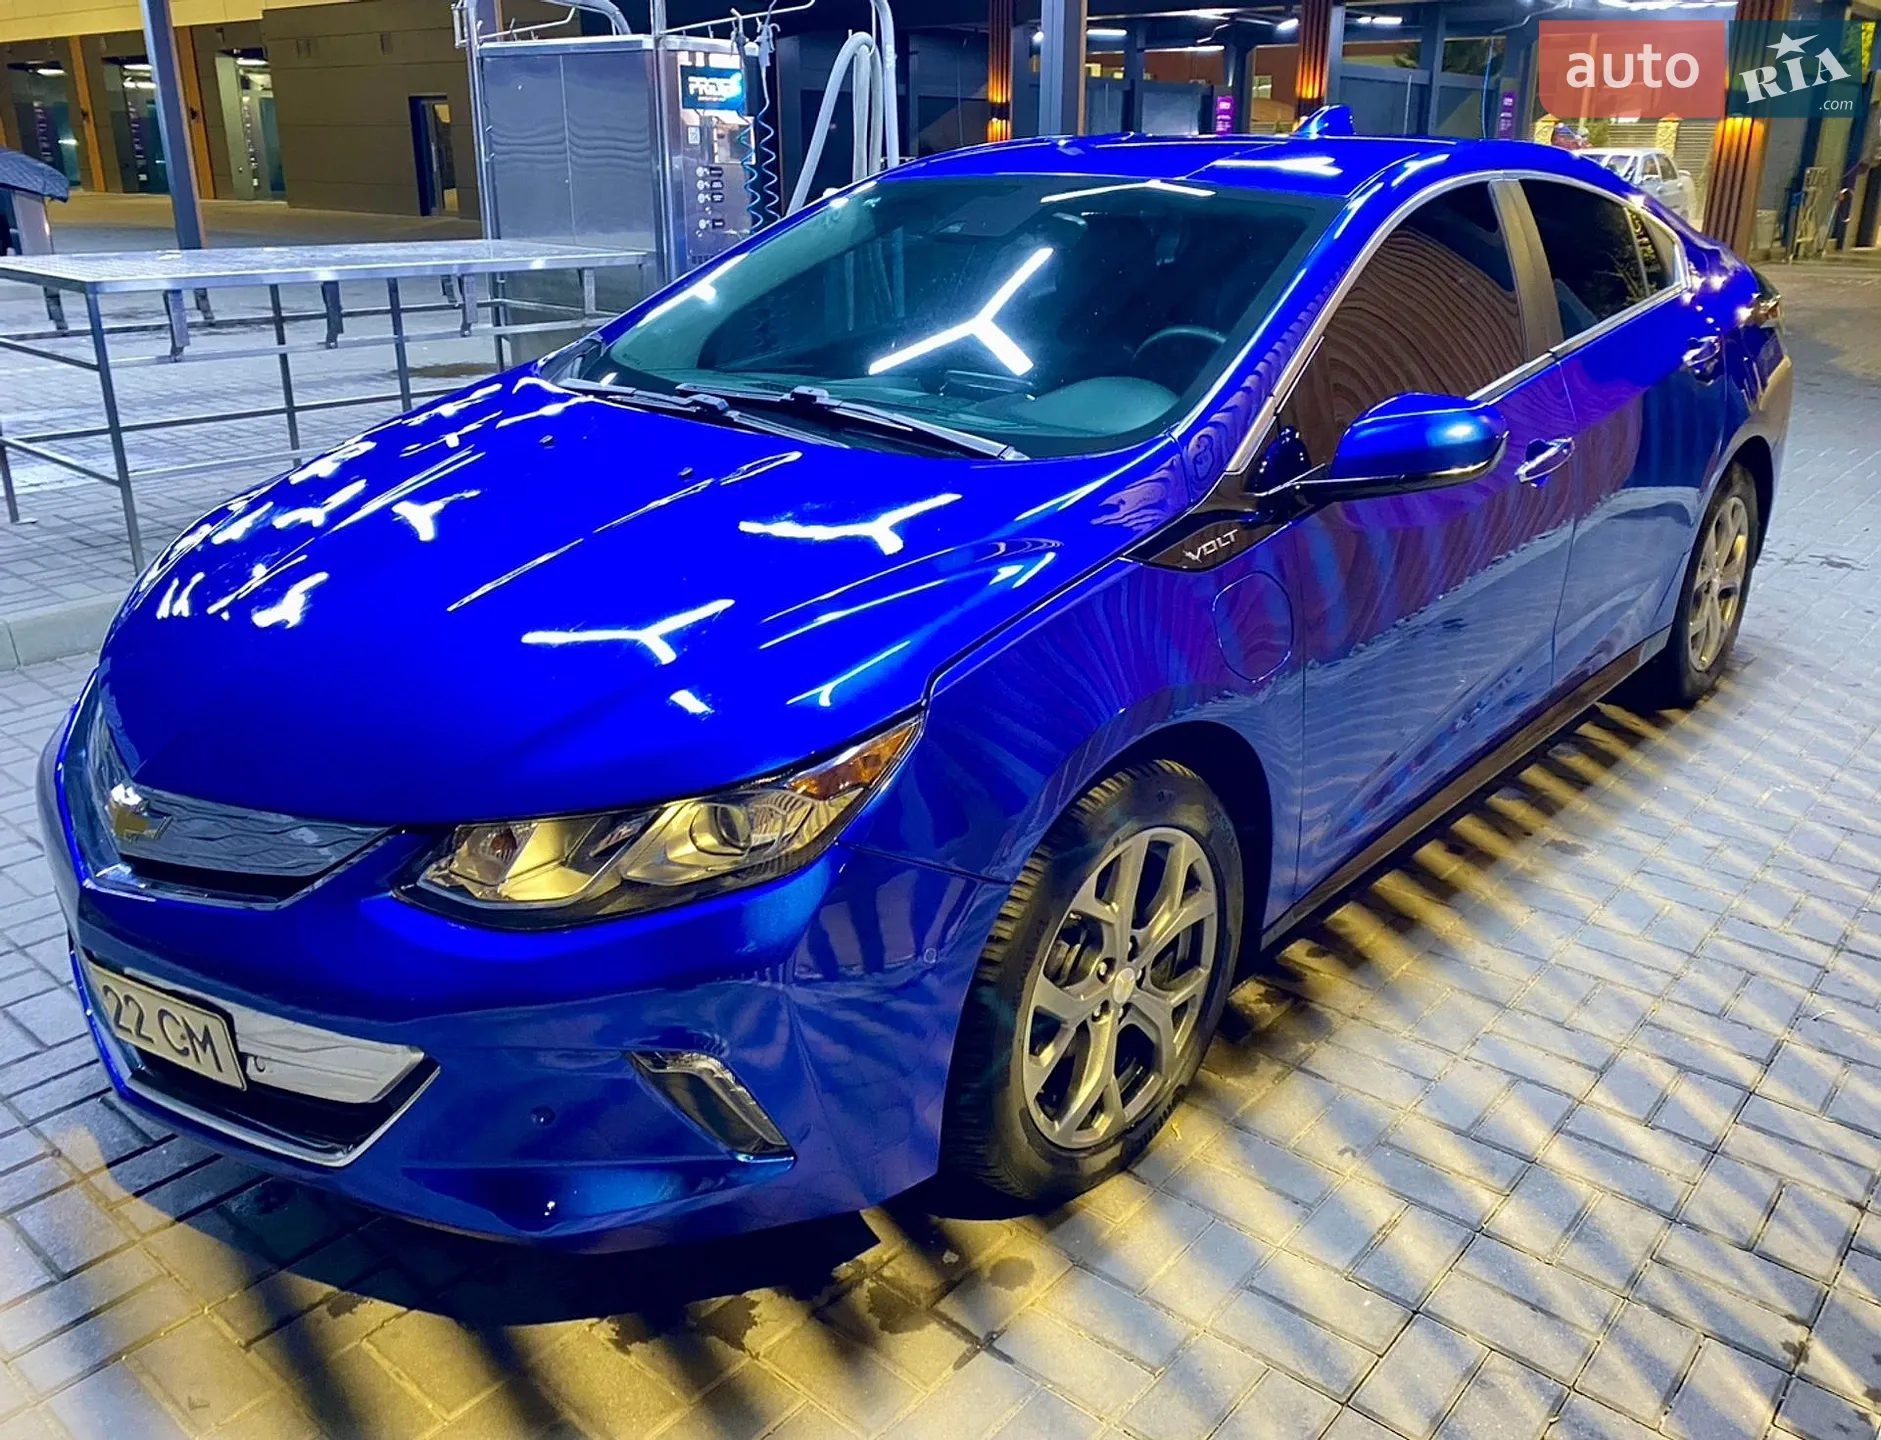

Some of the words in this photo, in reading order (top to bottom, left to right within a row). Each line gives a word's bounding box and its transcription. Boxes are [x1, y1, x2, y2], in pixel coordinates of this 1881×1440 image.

[1183, 529, 1238, 564] VOLT
[102, 984, 155, 1044] 22
[157, 1008, 224, 1073] CM
